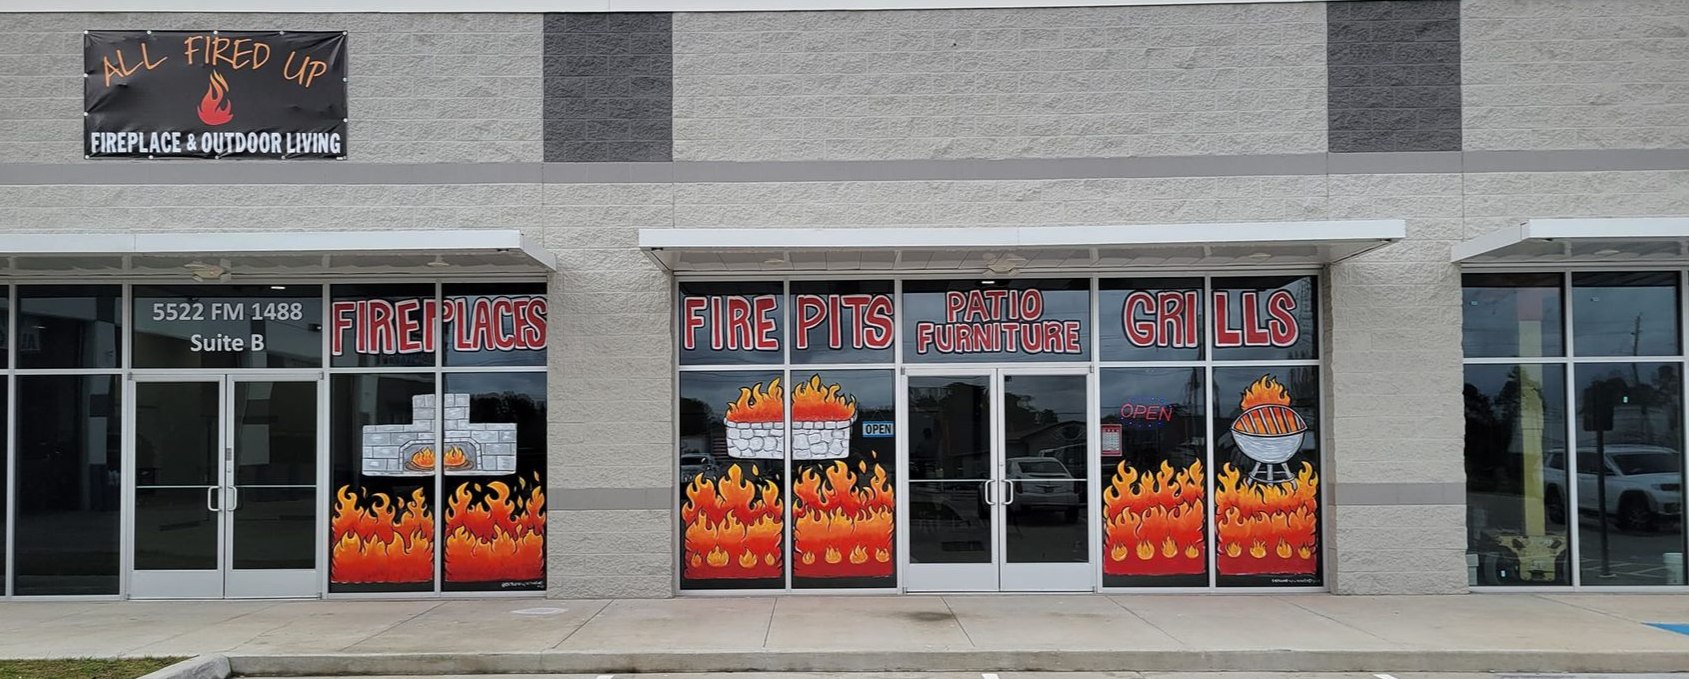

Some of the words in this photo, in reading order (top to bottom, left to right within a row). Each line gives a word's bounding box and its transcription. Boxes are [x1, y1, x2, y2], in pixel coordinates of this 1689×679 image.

[102, 43, 168, 88] ALL
[184, 35, 271, 70] FIRED
[283, 51, 327, 88] UP
[91, 132, 182, 154] FIREPLACE
[186, 134, 197, 152] &
[201, 132, 282, 154] OUTDOOR
[286, 132, 341, 154] LIVING
[152, 303, 204, 321] 5522
[211, 303, 244, 321] FM
[251, 303, 303, 321] 1488
[946, 288, 1043, 323] PATIO
[1123, 290, 1299, 348] GRILLS
[683, 294, 780, 351] FIRE
[795, 294, 894, 350] PITS
[190, 333, 244, 351] Suite
[251, 334, 265, 351] B
[917, 321, 1082, 354] FURNITURE
[1120, 403, 1173, 422] OPEN
[865, 424, 892, 435] OPEN
